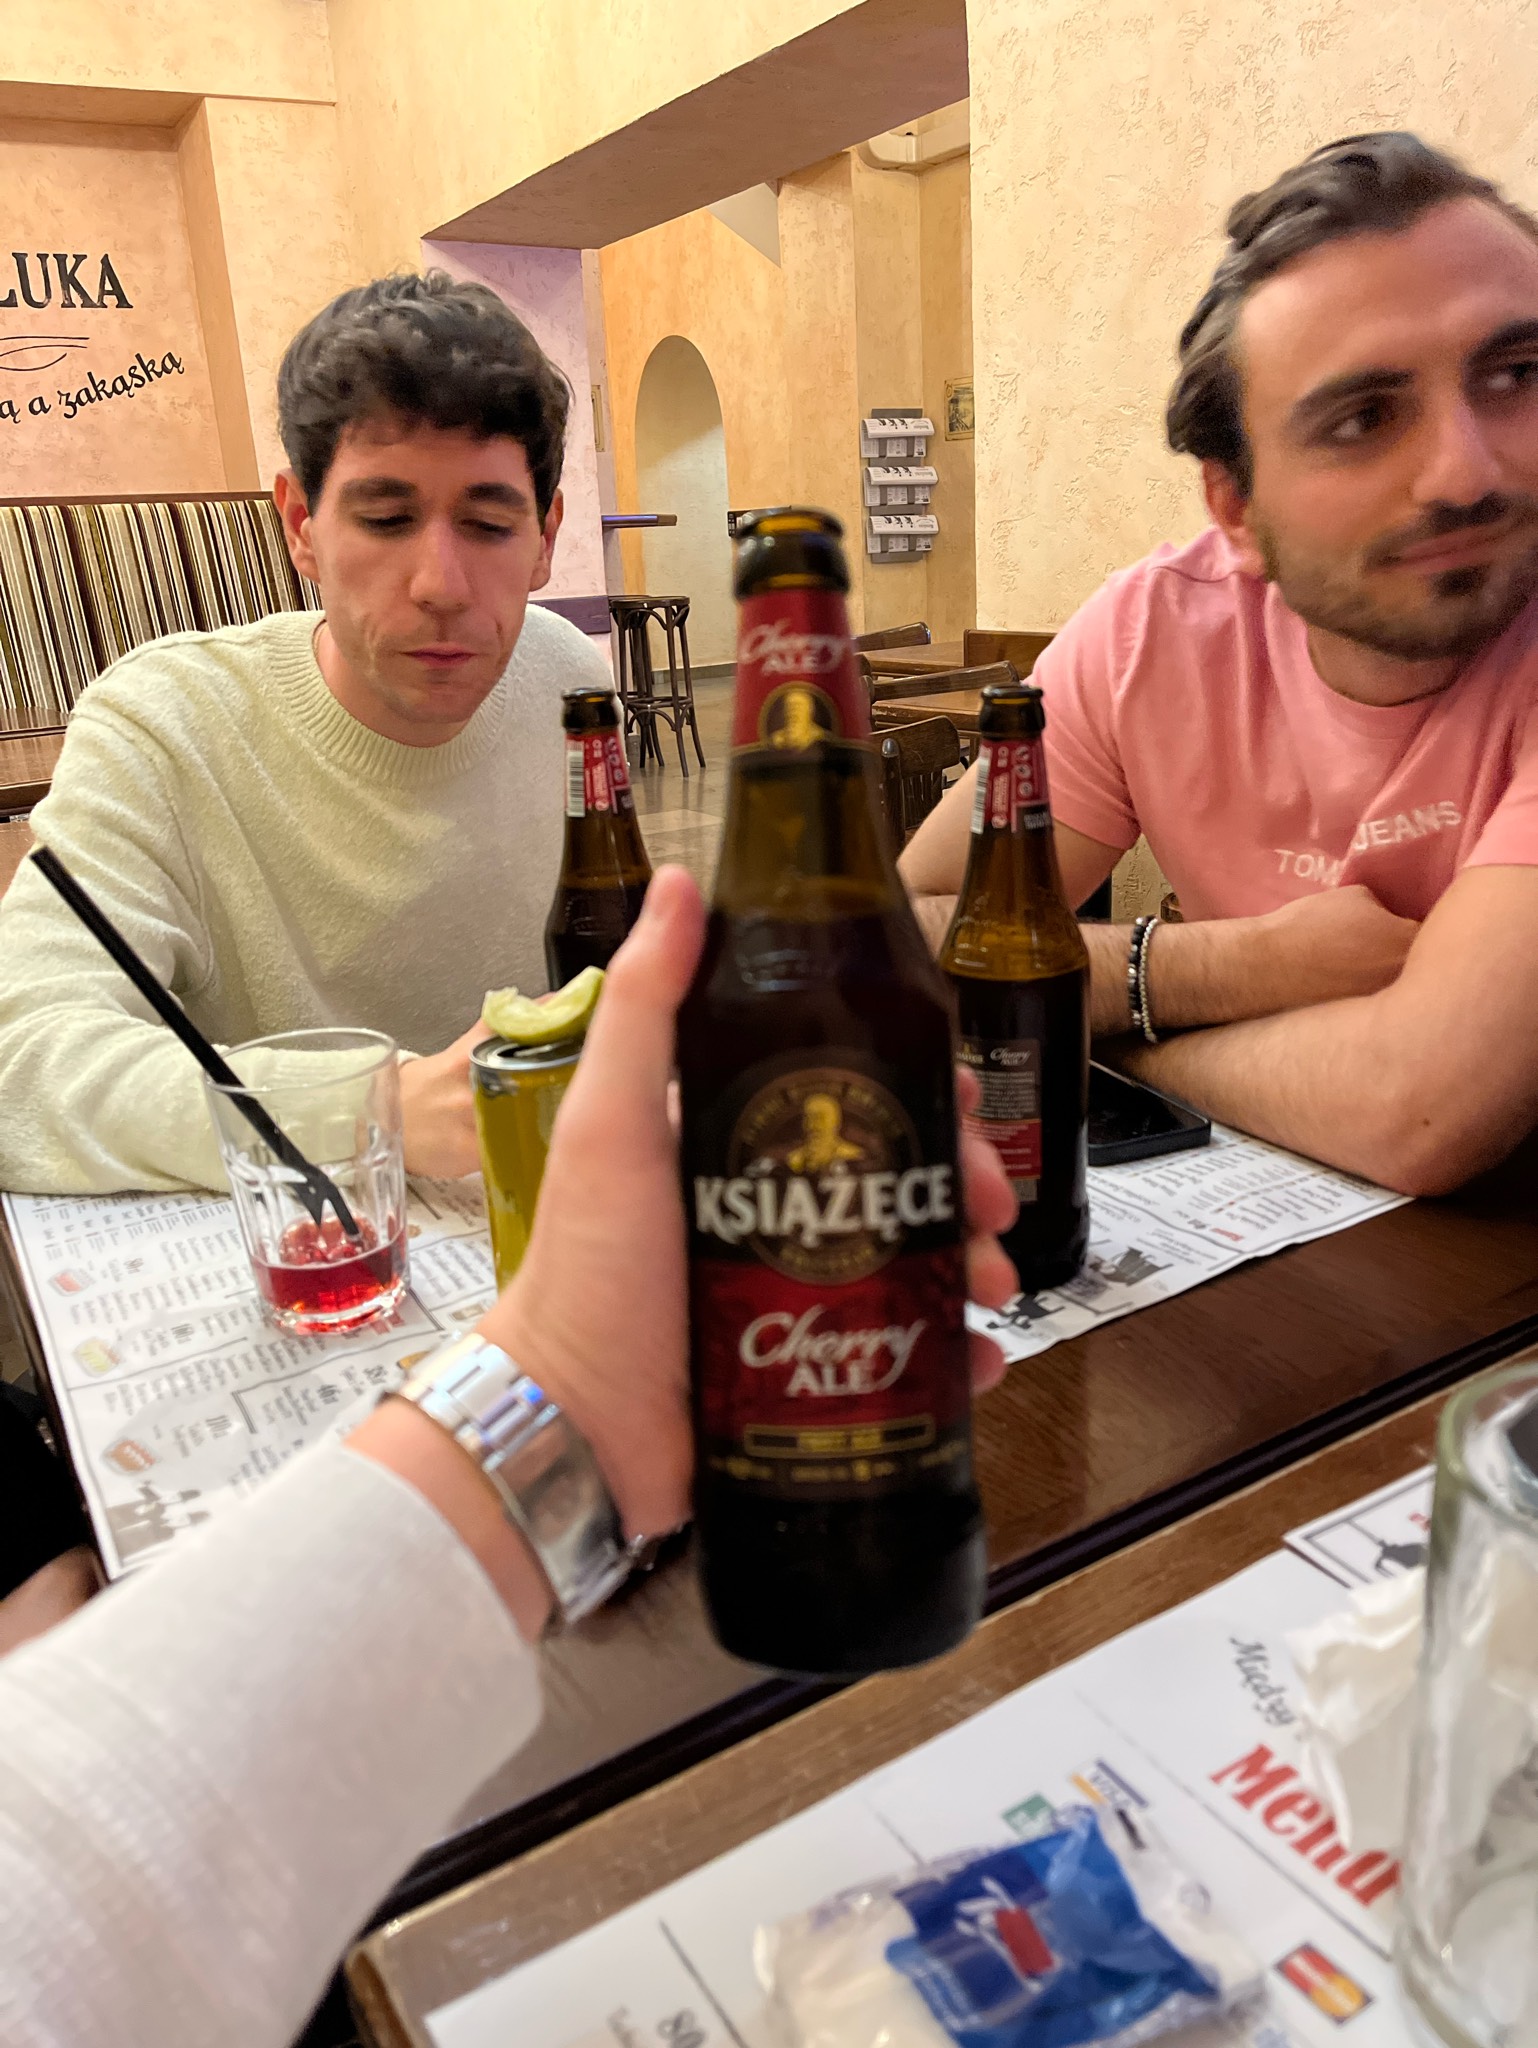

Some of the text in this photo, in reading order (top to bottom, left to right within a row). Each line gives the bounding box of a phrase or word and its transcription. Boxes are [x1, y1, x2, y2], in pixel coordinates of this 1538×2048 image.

[28, 396, 52, 416] a
[57, 351, 185, 419] zakąską
[1351, 800, 1462, 853] JEANS
[693, 1155, 955, 1249] KSIĄŻĘCE
[739, 1303, 928, 1392] Cherry
[785, 1362, 873, 1398] ALE
